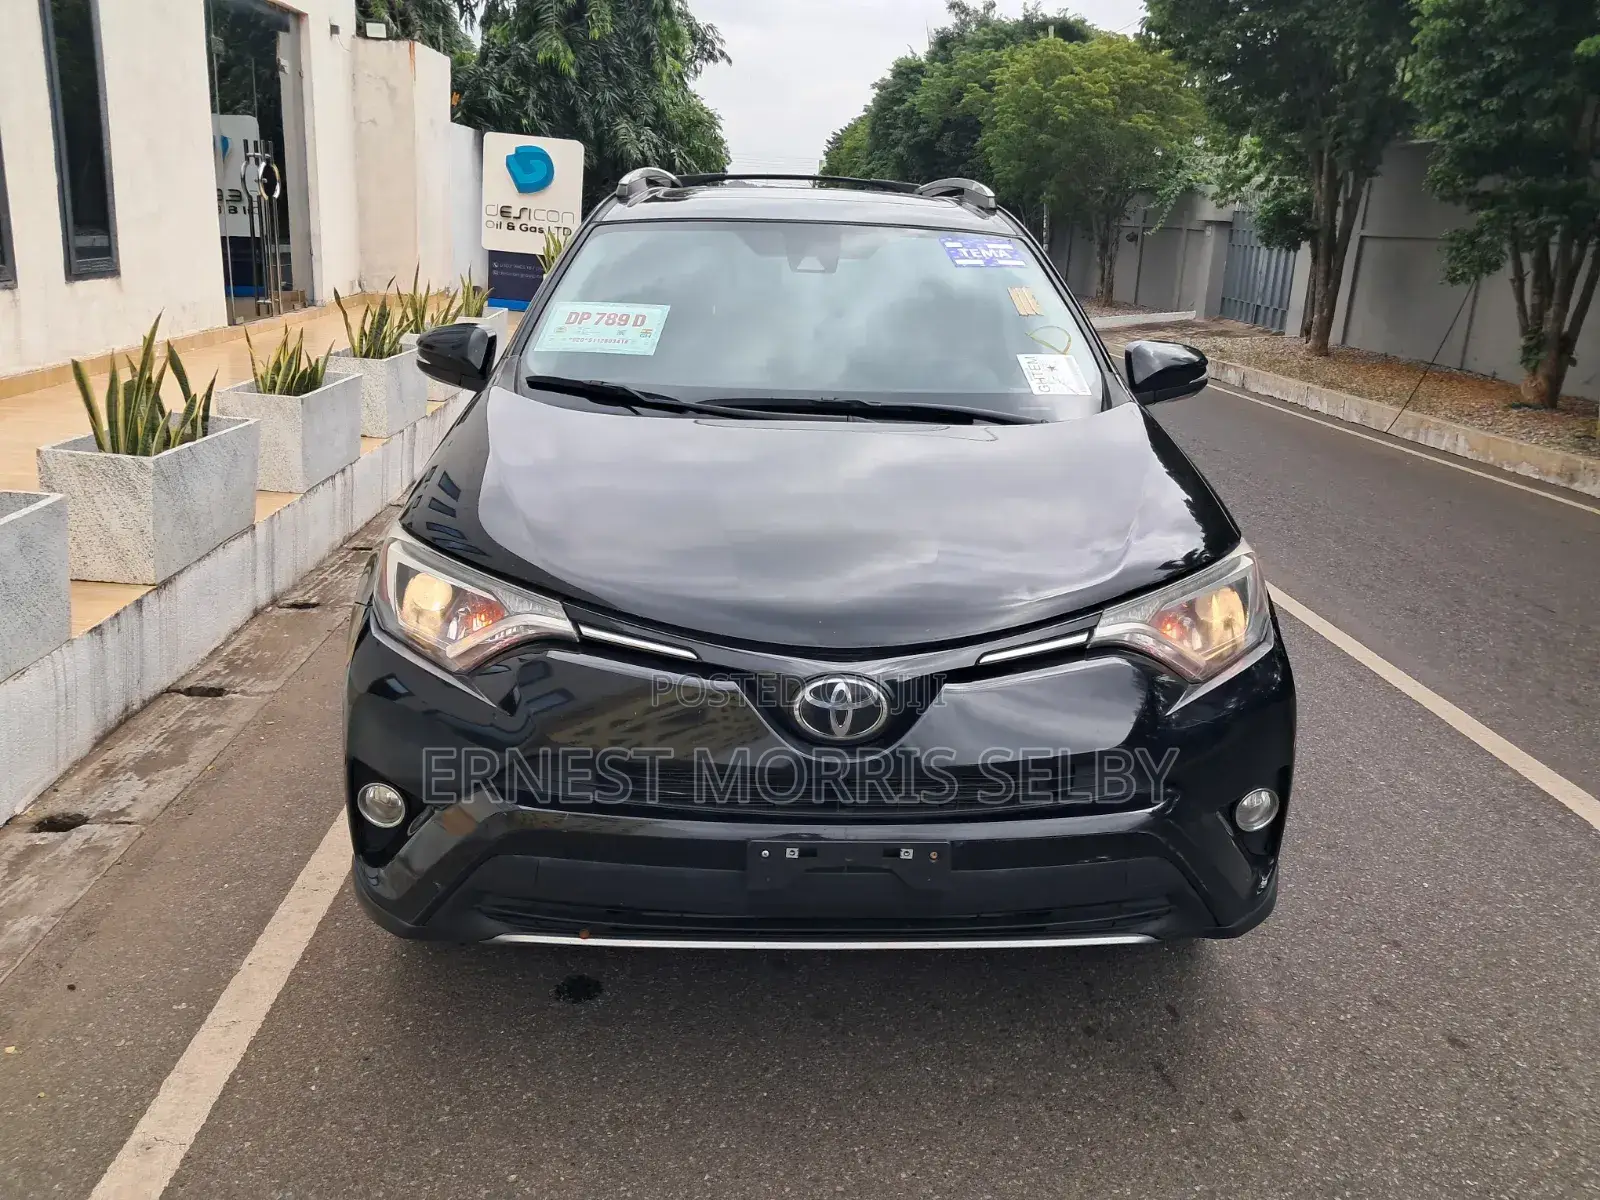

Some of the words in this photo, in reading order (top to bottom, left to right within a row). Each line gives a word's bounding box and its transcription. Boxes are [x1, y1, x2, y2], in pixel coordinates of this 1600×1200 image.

[485, 220, 502, 230] Oil
[506, 221, 516, 231] &
[519, 223, 545, 233] Gas
[956, 247, 1013, 259] TEMA
[565, 311, 592, 325] DP
[594, 312, 631, 327] 789
[632, 314, 647, 327] D
